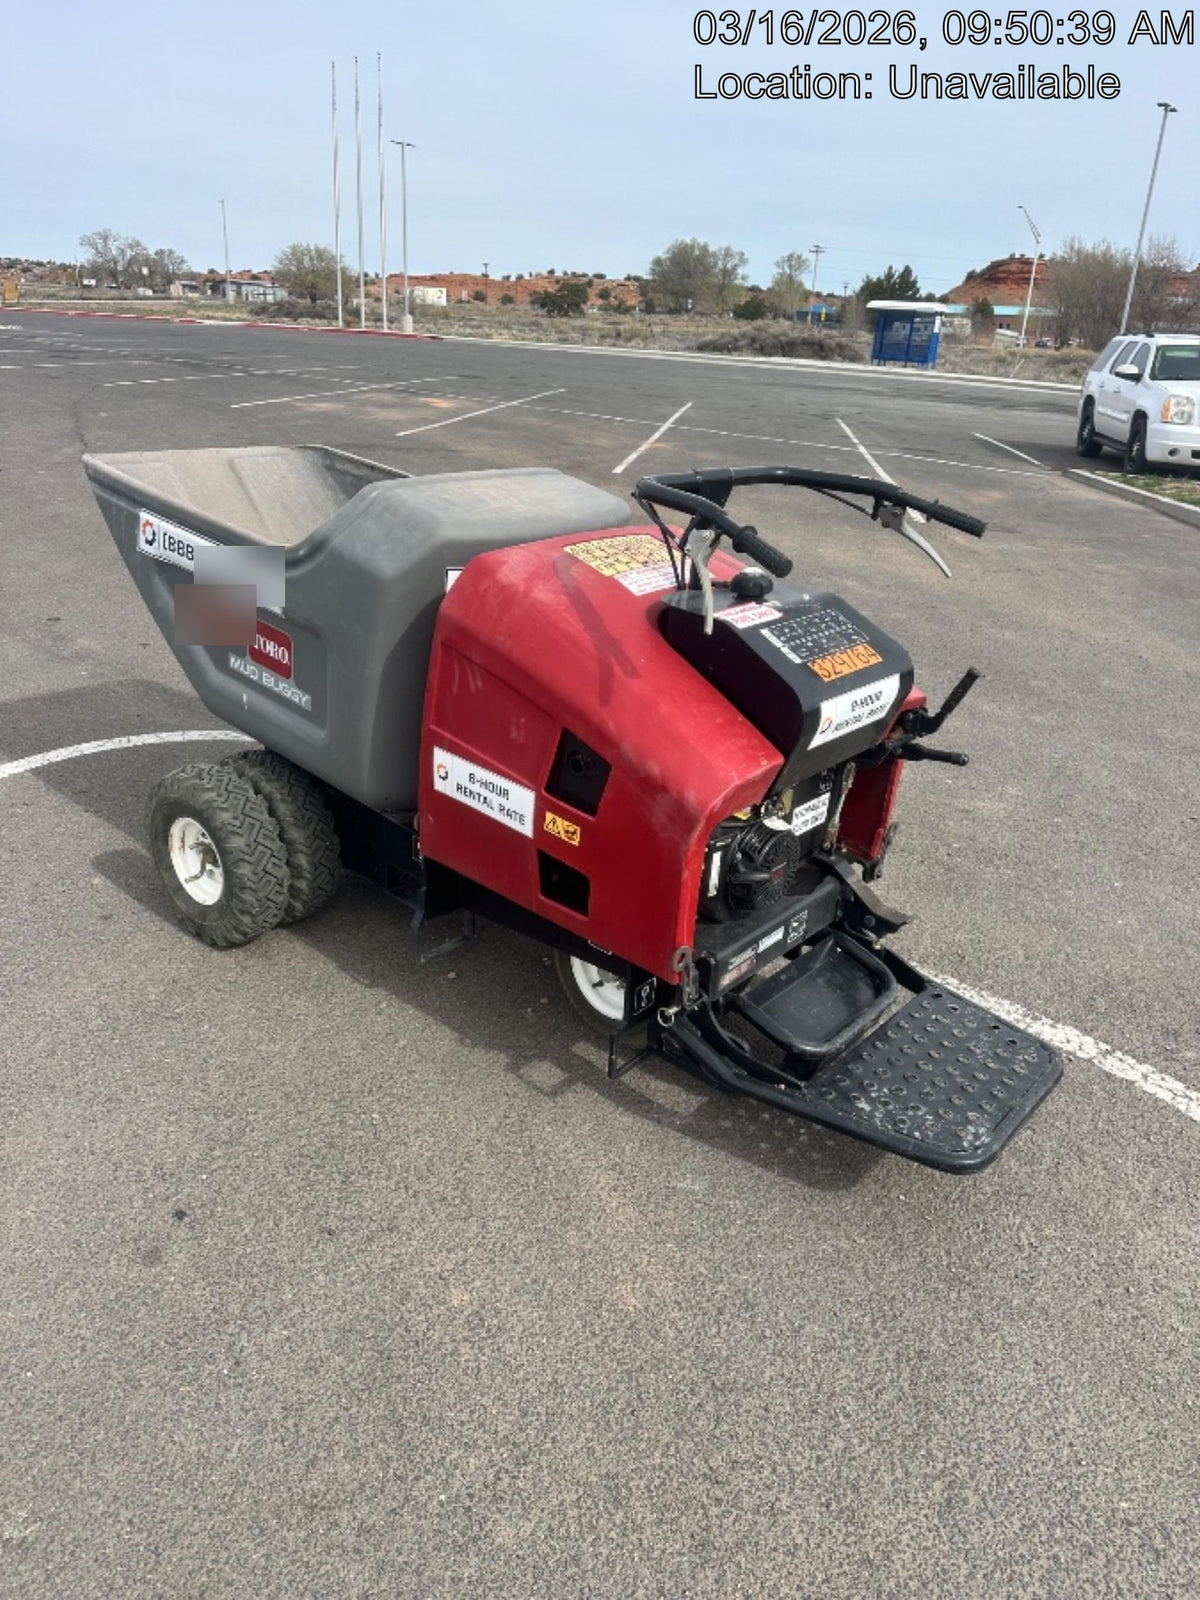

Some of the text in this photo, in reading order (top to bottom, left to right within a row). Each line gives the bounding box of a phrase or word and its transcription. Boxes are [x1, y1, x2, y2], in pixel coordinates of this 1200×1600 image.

[229, 655, 309, 706] MUD BUGGY
[456, 782, 526, 826] RENTAL RATE
